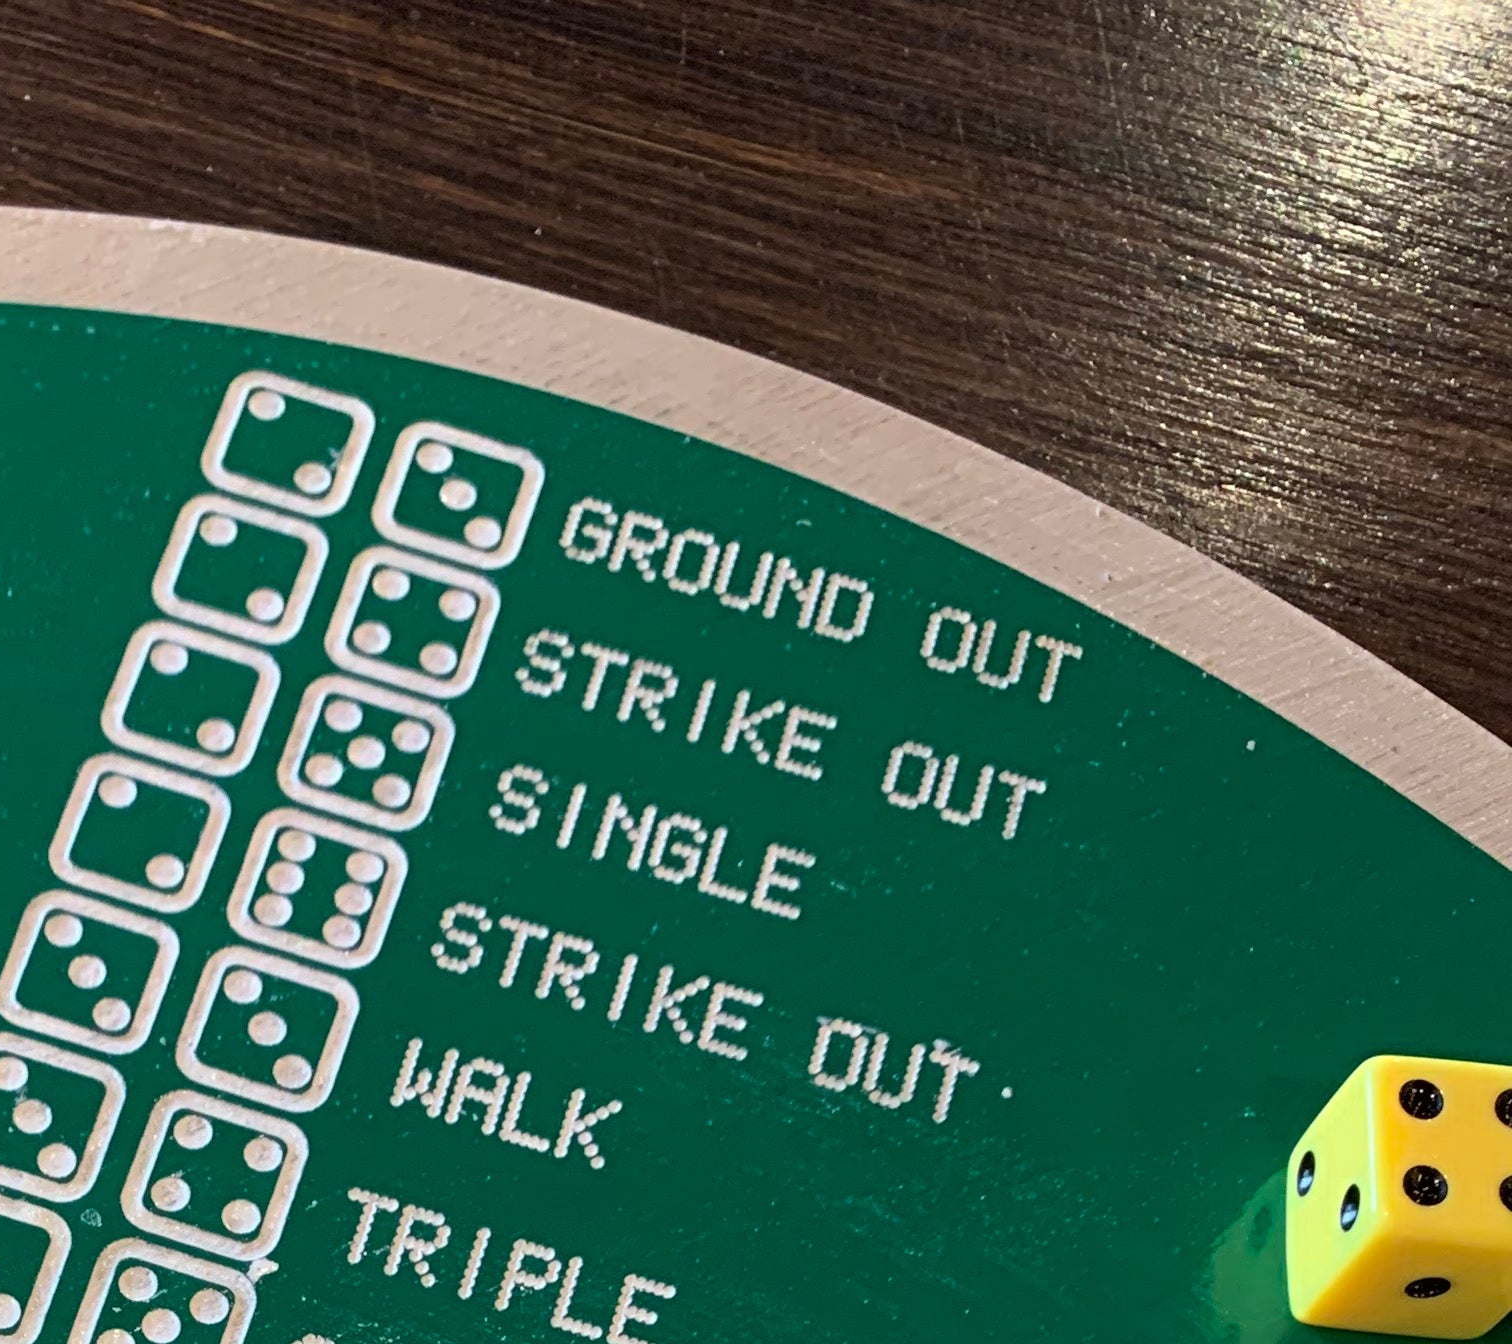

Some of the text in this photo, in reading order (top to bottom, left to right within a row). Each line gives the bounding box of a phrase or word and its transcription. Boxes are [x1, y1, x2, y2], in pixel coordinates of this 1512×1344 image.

[560, 498, 1082, 702] GROUND OUT
[516, 630, 1046, 839] STRIKE OUT
[490, 765, 814, 919] SINGLE
[390, 1039, 622, 1168] WALK
[431, 903, 979, 1123] STRIKE OUT
